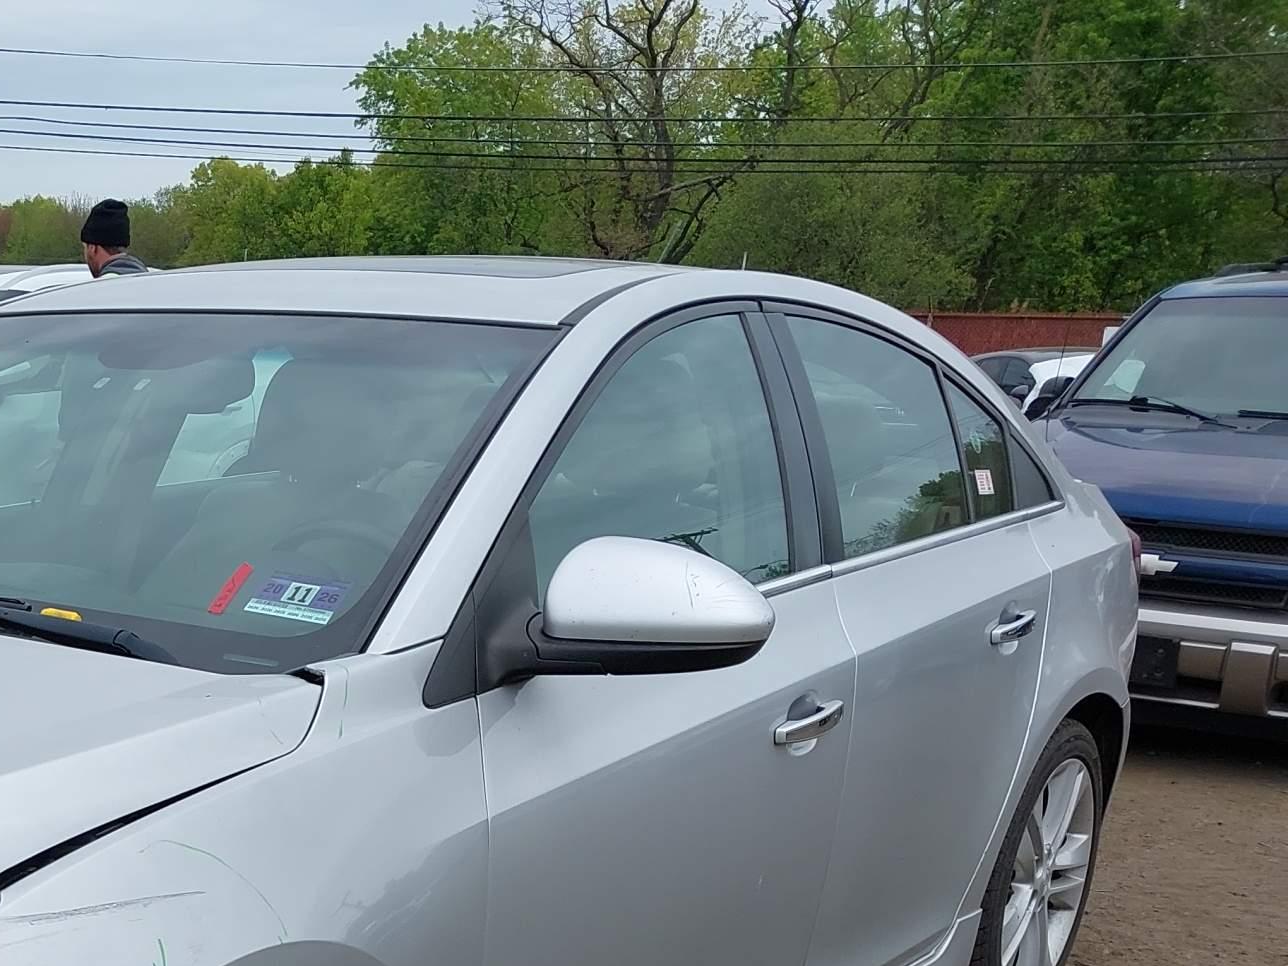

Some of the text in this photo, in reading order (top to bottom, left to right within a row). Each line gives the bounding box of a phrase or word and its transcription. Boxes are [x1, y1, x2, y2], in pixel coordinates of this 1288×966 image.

[263, 582, 340, 604] 20 11 26
